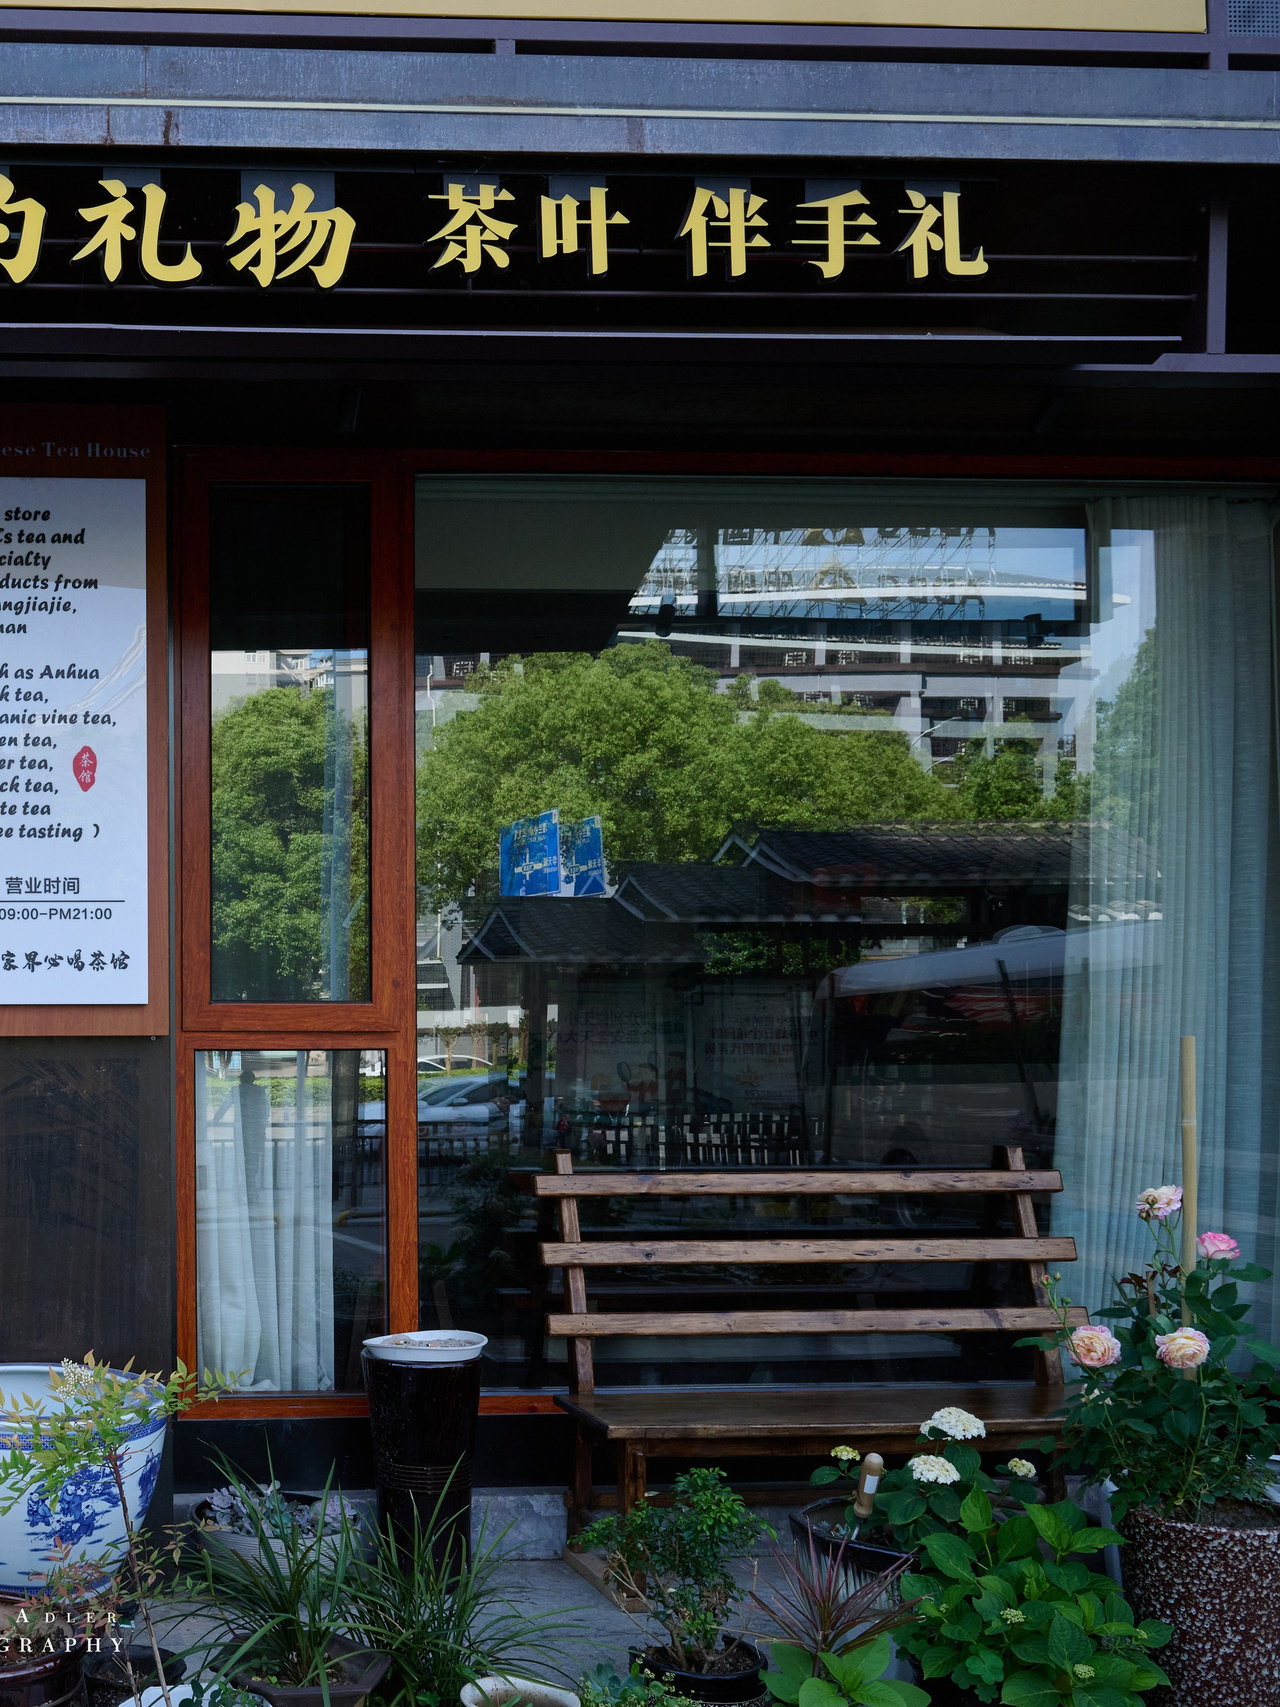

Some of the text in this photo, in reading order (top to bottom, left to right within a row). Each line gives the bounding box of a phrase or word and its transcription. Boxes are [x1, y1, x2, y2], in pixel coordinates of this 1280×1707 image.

[426, 183, 631, 278] 茶叶
[677, 187, 989, 280] 伴手礼
[41, 442, 80, 458] Tea
[87, 442, 151, 458] House
[4, 507, 51, 521] store
[17, 530, 47, 544] tea
[51, 528, 86, 545] and
[54, 574, 99, 592] from
[13, 667, 34, 680] as
[39, 663, 100, 680] Anhua
[15, 688, 49, 704] tea,
[41, 709, 78, 725] vine
[83, 711, 117, 727] tea,
[23, 733, 57, 750] tea,
[19, 756, 54, 772] tea,
[78, 752, 94, 784] 茶馆
[24, 779, 59, 795] tea,
[22, 801, 51, 816] tea
[18, 823, 83, 842] tasting
[5, 877, 80, 895] 营业时间
